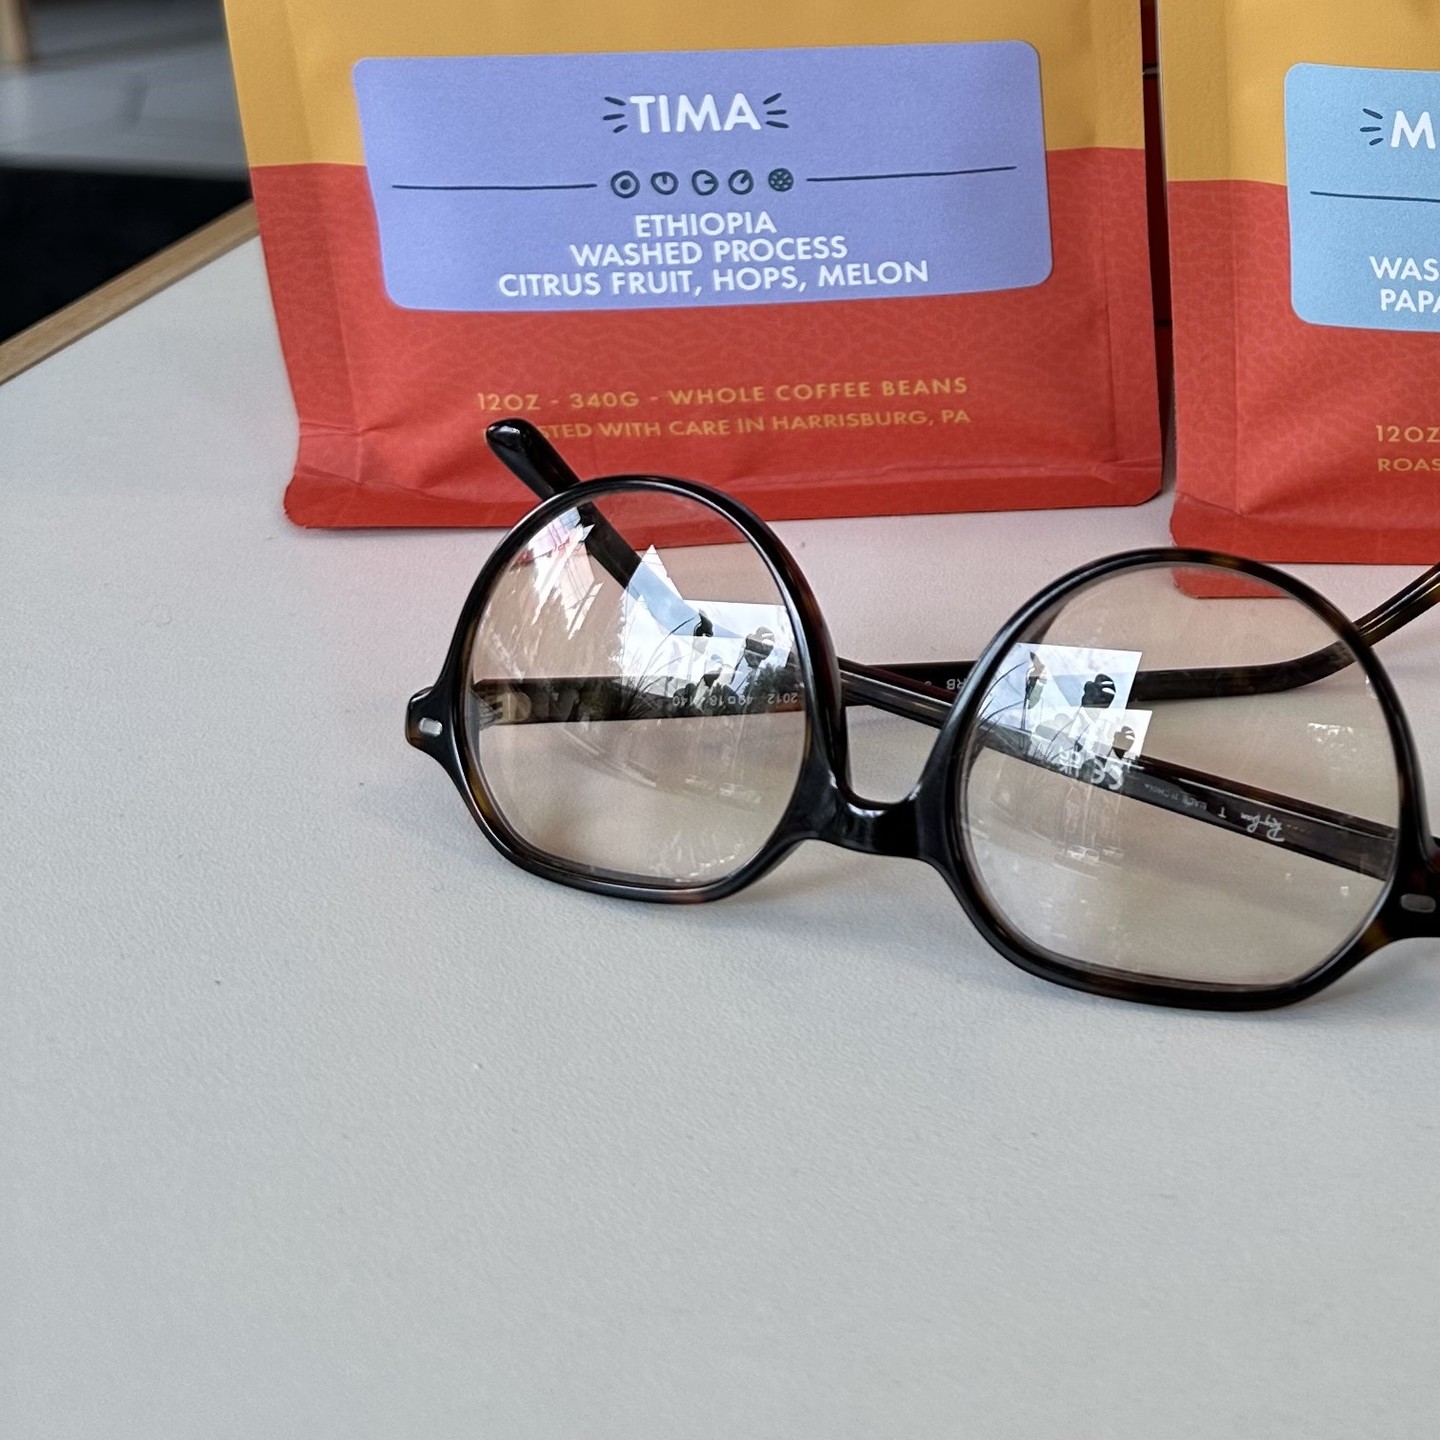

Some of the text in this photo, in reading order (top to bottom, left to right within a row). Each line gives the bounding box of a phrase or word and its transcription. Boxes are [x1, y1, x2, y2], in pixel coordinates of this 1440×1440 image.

[630, 93, 761, 133] TIMA
[636, 212, 777, 237] ETHIOPIA
[570, 236, 847, 266] WASHED PROCESS
[499, 261, 927, 296] CITRUS FRUIT, HOPS, MELON
[478, 393, 538, 411] 12OZ
[570, 392, 639, 408] 340G
[668, 387, 764, 404] WHOLE
[776, 382, 869, 400] COFFEE
[882, 377, 966, 396] BEANS
[599, 423, 660, 436] WITH
[669, 420, 728, 435] CARE
[737, 417, 764, 433] IN
[772, 411, 932, 430] HARRISBURG,
[942, 410, 970, 422] PA
[1376, 425, 1439, 442] 12OZ
[767, 692, 799, 704] 2012
[1240, 811, 1285, 842] Ray-Ban
